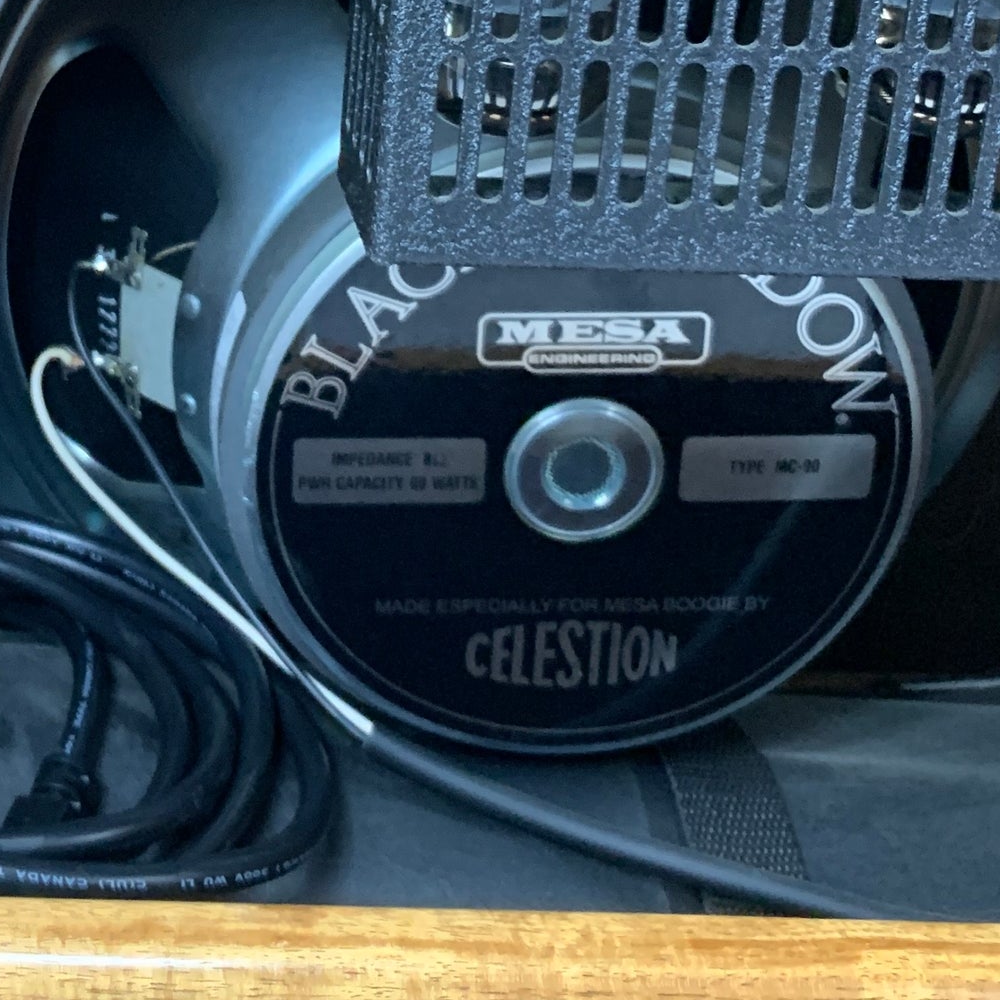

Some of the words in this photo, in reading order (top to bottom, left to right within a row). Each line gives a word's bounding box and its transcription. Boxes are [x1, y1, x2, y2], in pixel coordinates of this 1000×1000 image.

[280, 264, 475, 420] BLAC
[496, 318, 691, 345] MESA
[528, 352, 656, 365] ENGINEERING
[730, 460, 765, 474] TYPE
[375, 599, 427, 615] MADE
[436, 598, 552, 614] ESPECIALLY
[557, 597, 600, 613] FOR
[743, 595, 770, 611] BY
[465, 619, 678, 688] CELESTION
[16, 868, 89, 891] CANADA
